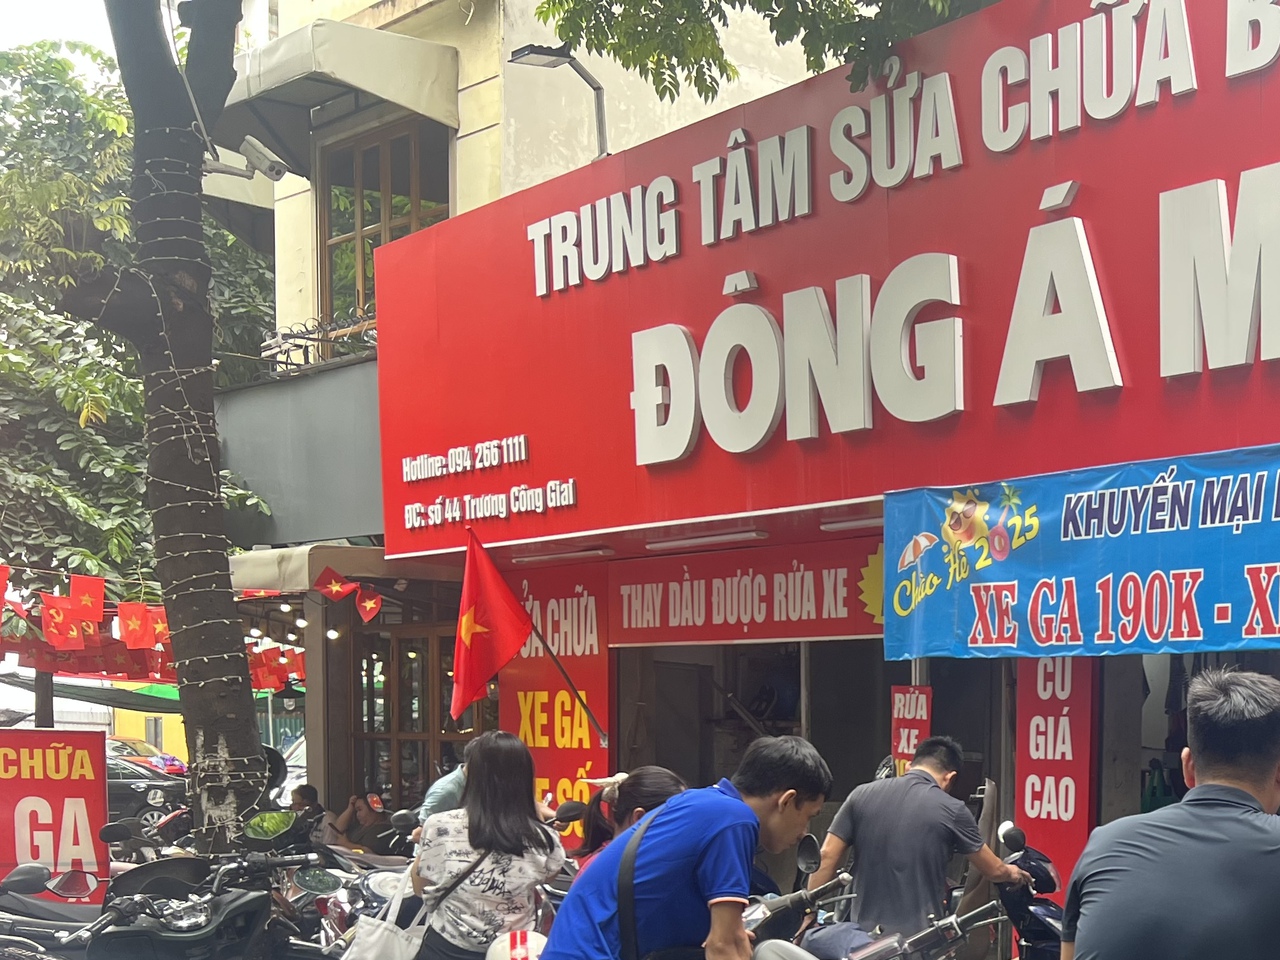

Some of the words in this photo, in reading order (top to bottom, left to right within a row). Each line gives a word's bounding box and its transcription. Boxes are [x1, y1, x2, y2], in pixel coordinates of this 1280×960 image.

[527, 175, 680, 297] TRUNG
[693, 127, 812, 246] TÂM
[829, 55, 964, 203] SỬA
[630, 270, 965, 467] ĐÔNG
[992, 180, 1124, 407] Á
[402, 453, 446, 482] Hotline:
[447, 446, 472, 474] 094
[474, 440, 501, 469] 266
[501, 434, 528, 464] 1111
[404, 503, 426, 529] ĐC:
[427, 495, 444, 525] số
[444, 497, 462, 522] 44
[509, 484, 545, 514] Công
[1060, 465, 1195, 541] KHUYẾN
[1198, 471, 1269, 534] MẠI
[944, 540, 970, 590] Hè
[512, 579, 545, 659] ỬA
[546, 584, 599, 657] CHỮA
[620, 582, 664, 628] THAY
[668, 565, 706, 627] DẦU
[711, 568, 767, 633] ĐƯỢC
[773, 559, 817, 622] RỬA
[821, 567, 849, 620] XE
[968, 579, 1019, 648] XE
[1027, 576, 1084, 647] GA
[1094, 568, 1204, 644] 190K
[516, 690, 550, 748] XE
[553, 689, 591, 750] GA
[893, 687, 928, 720] RỬA
[0, 743, 96, 781] CHỮA
[897, 728, 920, 754] XE
[1028, 707, 1073, 761] GIÁ
[1024, 774, 1076, 822] CAO
[14, 796, 99, 873] GA
